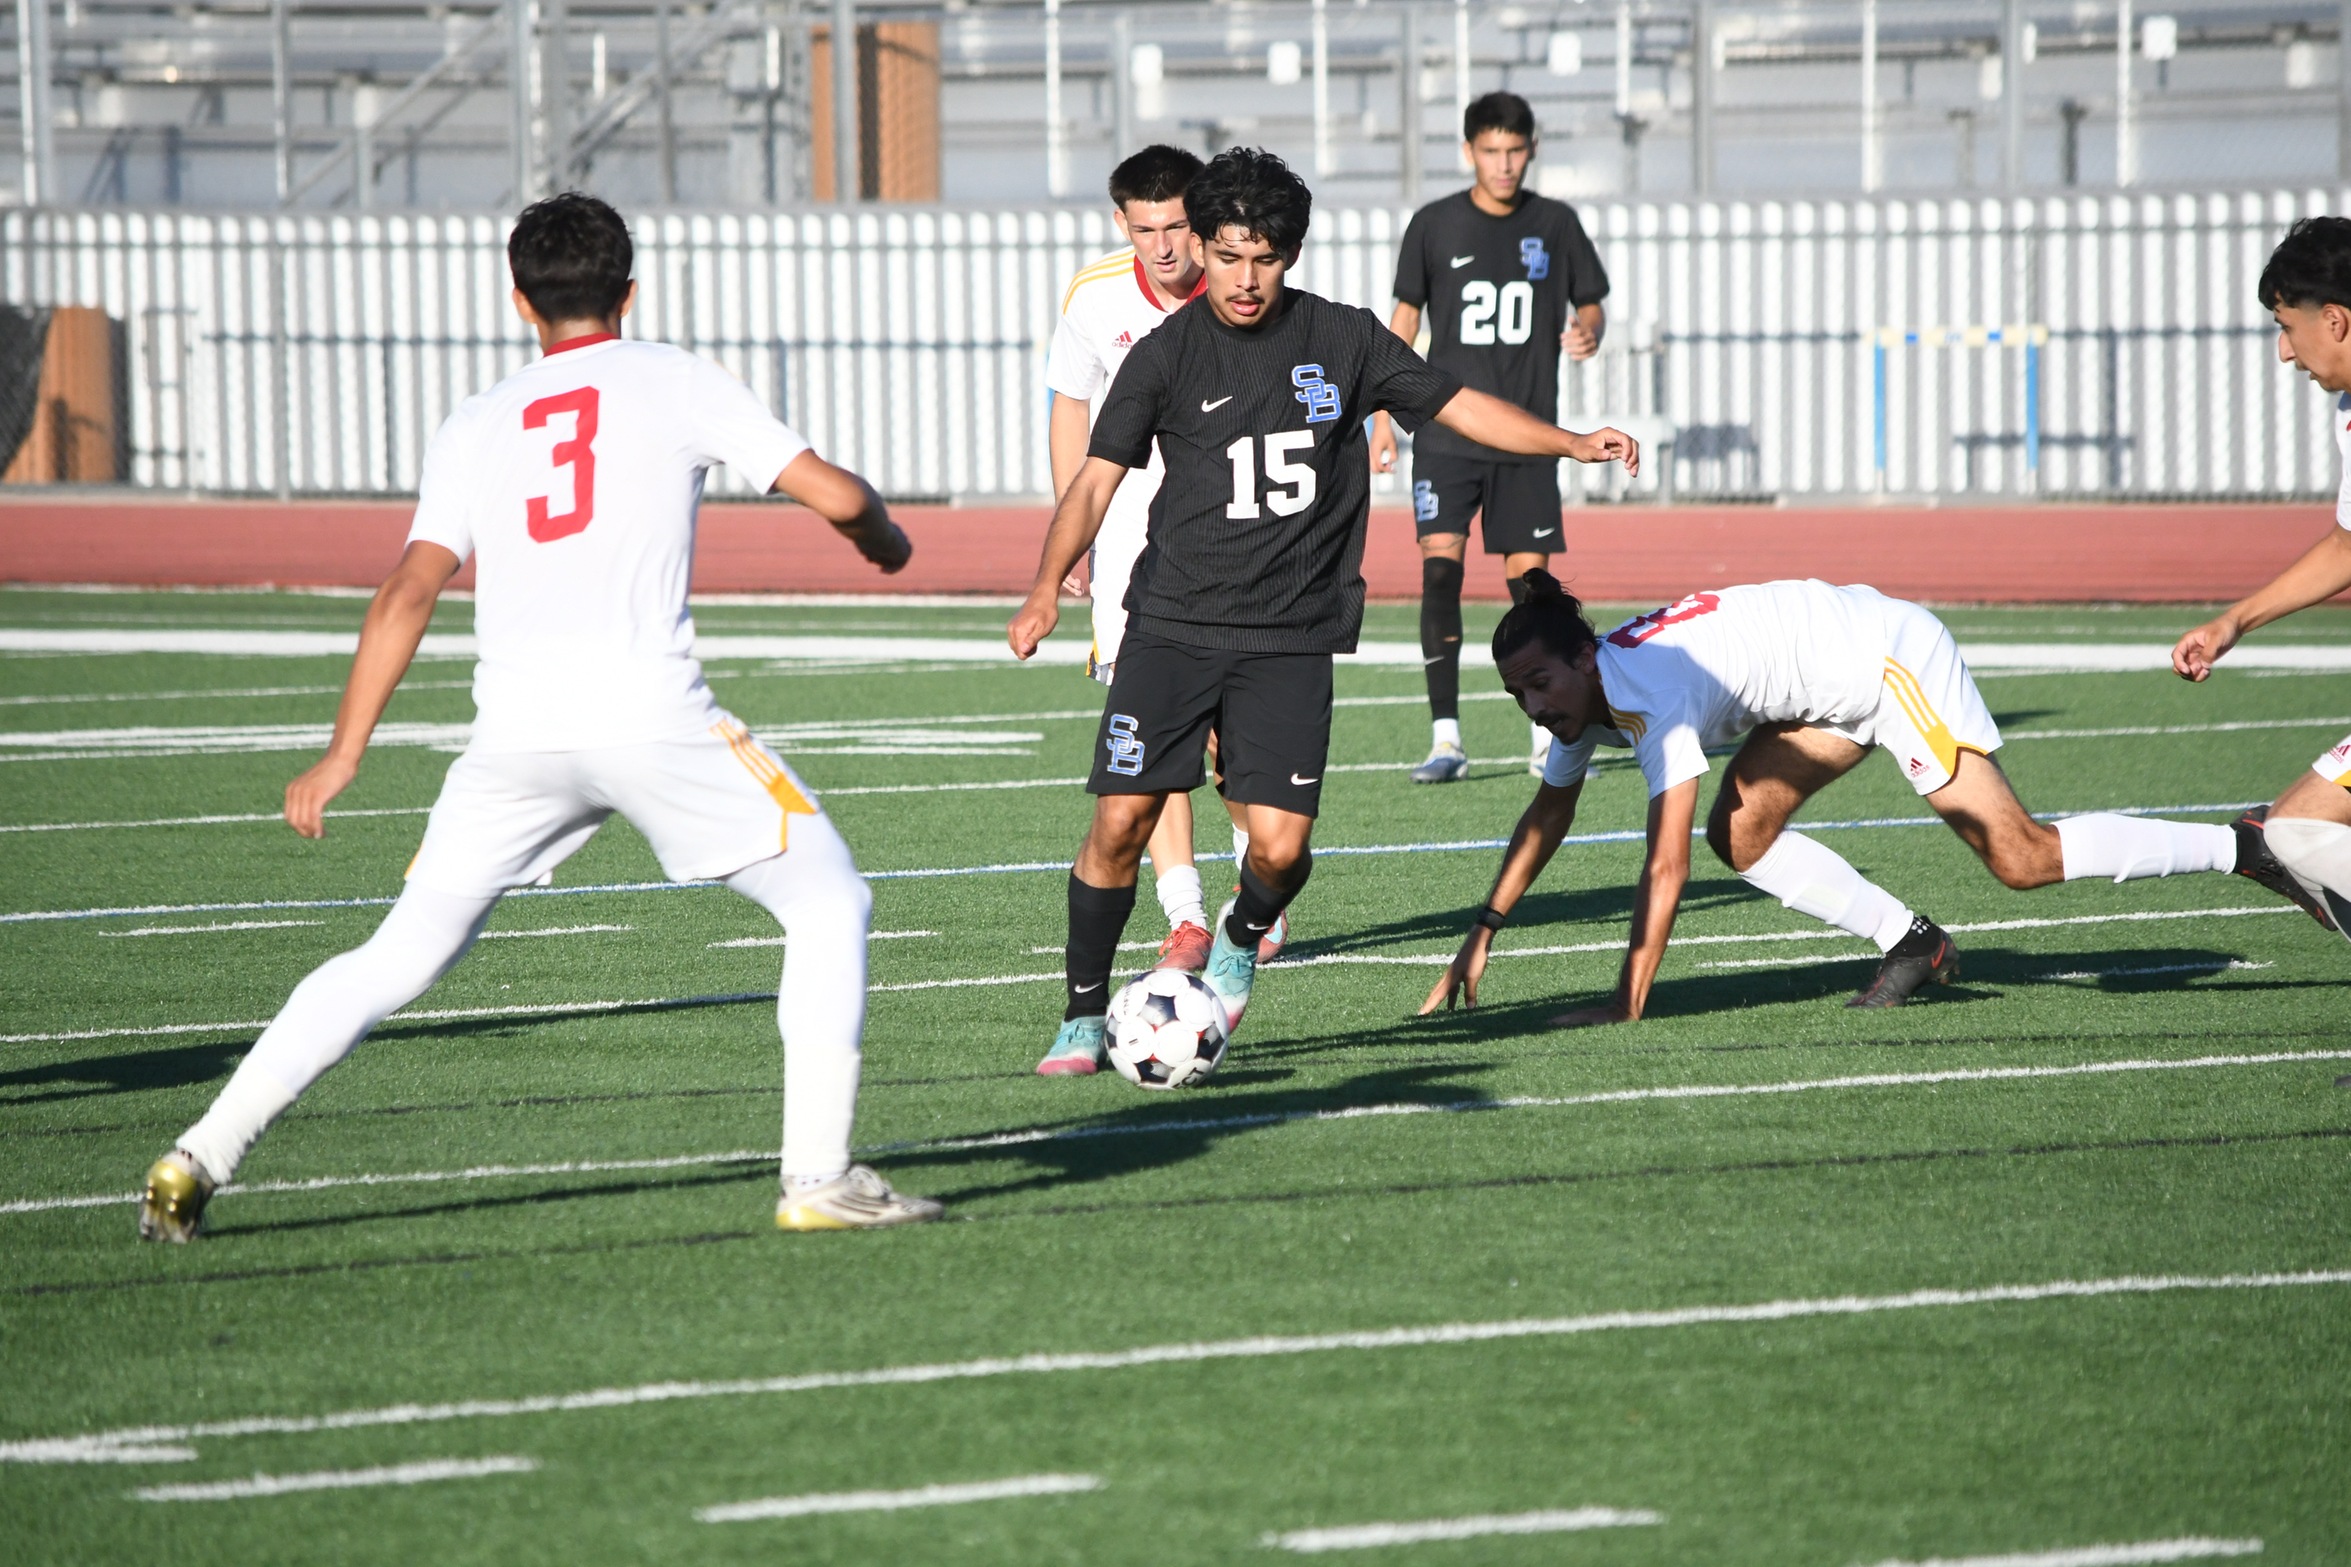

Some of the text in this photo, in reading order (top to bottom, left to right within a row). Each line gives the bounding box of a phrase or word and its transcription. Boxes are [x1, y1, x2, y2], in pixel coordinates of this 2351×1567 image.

[1460, 280, 1534, 345] 20
[1291, 363, 1342, 423] SB
[523, 385, 600, 544] 3
[1226, 429, 1317, 519] 15
[1106, 713, 1146, 777] SB
